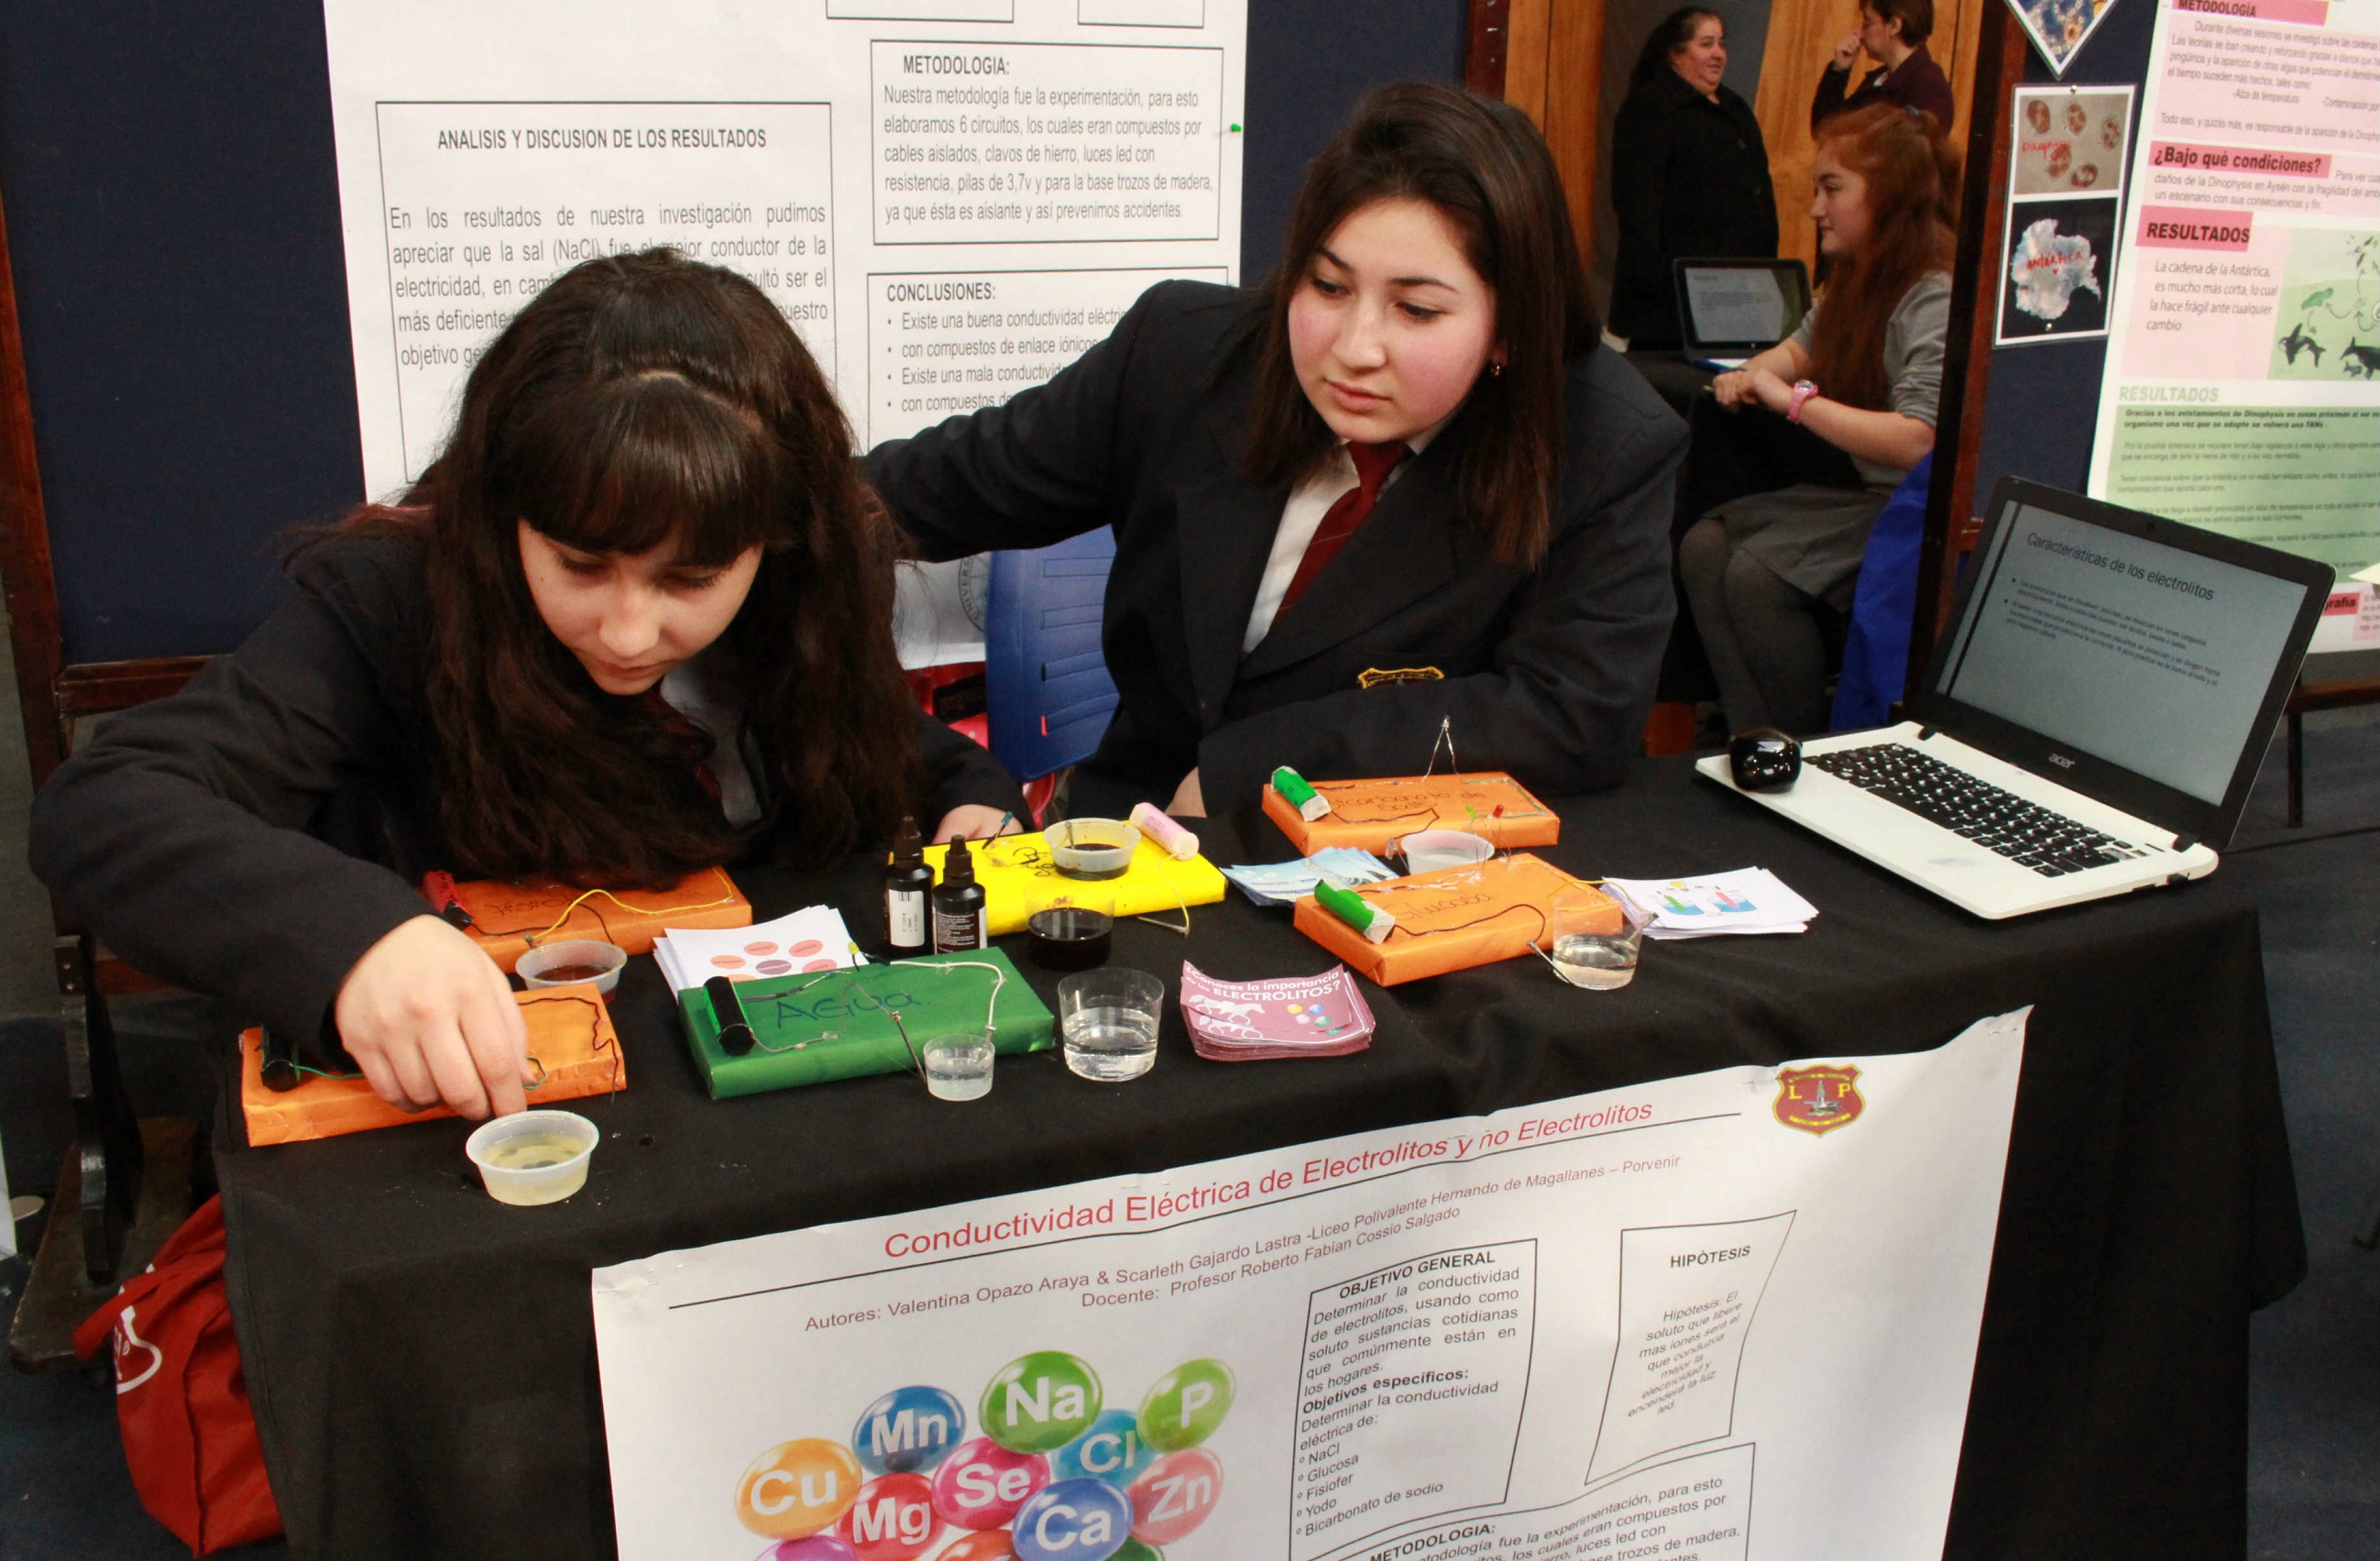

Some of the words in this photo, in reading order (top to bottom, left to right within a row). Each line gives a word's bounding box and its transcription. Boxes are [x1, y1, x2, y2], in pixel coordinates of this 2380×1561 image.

[903, 55, 1010, 74] METODOLOGIA:
[884, 84, 932, 104] Nuestra
[936, 85, 1009, 109] metodología
[1014, 86, 1032, 104] fue
[1036, 87, 1046, 105] la
[1049, 87, 1144, 109] experimentación,
[1148, 91, 1172, 111] para
[1176, 90, 1199, 107] esto
[438, 129, 507, 150] ANALISIS
[513, 129, 521, 149] Y
[526, 128, 608, 149] DISCUSION
[613, 128, 632, 148] DE
[638, 128, 667, 148] LOS
[672, 127, 767, 148] RESULTADOS
[884, 115, 955, 134] elaboramos
[960, 115, 967, 133] 6
[971, 115, 1023, 137] circuitos,
[1027, 116, 1043, 134] los
[1047, 116, 1083, 134] cuales
[1088, 119, 1112, 135] eran
[1116, 118, 1180, 138] compuestos
[1185, 120, 1201, 138] por
[2155, 147, 2199, 170] ¿Bajo
[2233, 154, 2321, 173] condiciones?
[390, 207, 411, 229] En
[426, 206, 448, 228] los
[464, 205, 542, 227] resultados
[557, 204, 575, 226] de
[591, 203, 644, 225] nuestra
[660, 203, 751, 229] investigación
[767, 202, 826, 228] pudimos
[2146, 223, 2251, 244] RESULTADOS
[2168, 261, 2203, 274] cadena
[2206, 262, 2217, 275] de
[2220, 262, 2228, 275] la
[887, 282, 996, 302] CONCLUSIONES:
[2155, 282, 2166, 292] es
[2167, 280, 2201, 293] mucho
[2203, 281, 2222, 294] más
[2251, 282, 2258, 295] lo
[2260, 283, 2278, 296] cual
[902, 312, 938, 330] Existe
[942, 314, 963, 328] una
[967, 310, 1003, 327] buena
[1007, 308, 1084, 327] conductividad
[2149, 298, 2159, 311] la
[2160, 299, 2182, 312] hace
[2212, 301, 2231, 313] ante
[2232, 302, 2273, 320] cualquier
[2146, 318, 2182, 332] cambio
[2118, 386, 2220, 402] RESULTADOS
[2110, 558, 2126, 574] de
[2127, 563, 2145, 581] los
[2048, 753, 2076, 769] acer
[1186, 965, 1244, 992] ¿Conoces
[1247, 982, 1259, 992] la
[1263, 971, 1339, 991] importancia
[1213, 979, 1342, 1002] ELECTROLITOS?
[1788, 1084, 1804, 1100] L
[1837, 1083, 1852, 1098] P
[884, 1198, 1114, 1259] Conductividad
[1125, 1181, 1252, 1222] Eléctrica
[1259, 1169, 1293, 1193] de
[1302, 1137, 1448, 1184] Electrolitos
[1453, 1137, 1474, 1160] y
[1478, 1129, 1510, 1150] no
[1517, 1103, 1653, 1142] Electrolitos
[805, 1308, 882, 1332] Autores:
[888, 1292, 970, 1317] Valentina
[976, 1281, 1034, 1303] Opazo
[1038, 1275, 1090, 1292] Araya
[1097, 1270, 1110, 1284] &
[1115, 1260, 1185, 1284] Scarleth
[1190, 1245, 1251, 1270] Gajardo
[1255, 1231, 1301, 1255] Lastra
[1306, 1220, 1350, 1241] -Liceo
[1355, 1195, 1428, 1229] Polivalente
[1431, 1180, 1499, 1206] Hernando
[1503, 1176, 1522, 1192] de
[1526, 1166, 1606, 1189] Magallanes
[1622, 1155, 1682, 1174] Porvenir
[1081, 1288, 1160, 1308] Docente:
[1169, 1269, 1237, 1296] Profesor
[1241, 1253, 1300, 1279] Roberto
[1304, 1238, 1352, 1261] Fabian
[1356, 1222, 1402, 1247] Cossio
[1405, 1206, 1461, 1231] Salgado
[1339, 1265, 1413, 1300] OBJETIVO
[1418, 1250, 1496, 1274] GENERAL
[1313, 1292, 1388, 1325] Determinar
[1396, 1284, 1409, 1298] la
[1418, 1267, 1520, 1292] conductividad
[1662, 1297, 1723, 1324] Hipótesis:
[1311, 1328, 1329, 1344] de
[1333, 1303, 1409, 1336] electrolitos,
[1415, 1292, 1471, 1311] usando
[1478, 1289, 1519, 1304] como
[1646, 1323, 1685, 1342] soluto
[1687, 1315, 1710, 1332] que
[1712, 1302, 1743, 1322] libere
[1308, 1338, 1349, 1362] soluto
[1357, 1315, 1431, 1345] sustancias
[1442, 1306, 1519, 1326] cotidianas
[1305, 1361, 1332, 1380] que
[1342, 1335, 1432, 1367] comúnmente
[1443, 1328, 1486, 1346] están
[1497, 1325, 1517, 1339] en
[1302, 1382, 1368, 1415] Objetivos
[1373, 1368, 1470, 1391] específicos:
[1303, 1381, 1324, 1398] los
[1328, 1364, 1385, 1391] hogares.
[1004, 1375, 1087, 1427] Na
[1180, 1380, 1214, 1429] P
[1300, 1398, 1374, 1434] Determinar
[1377, 1393, 1391, 1407] la
[1395, 1380, 1499, 1404] conductividad
[870, 1409, 949, 1457] Mn
[1300, 1421, 1354, 1452] eléctrica
[1356, 1413, 1379, 1430] de:
[1079, 1427, 1137, 1473] Cl
[1308, 1442, 1341, 1466] NaCl
[1307, 1453, 1360, 1483] Glucosa
[750, 1468, 838, 1517] Cu
[954, 1462, 1031, 1510] Se
[1146, 1470, 1213, 1523] Zn
[1306, 1472, 1355, 1501] Fisiofer
[851, 1496, 933, 1545] Mg
[1305, 1497, 1338, 1519] Yodo
[1305, 1497, 1381, 1537] Bicarbonato
[1384, 1490, 1401, 1505] de
[1405, 1481, 1444, 1500] sodio
[1035, 1503, 1113, 1553] Ca
[1369, 1523, 1497, 1561] METODOLOGIA:
